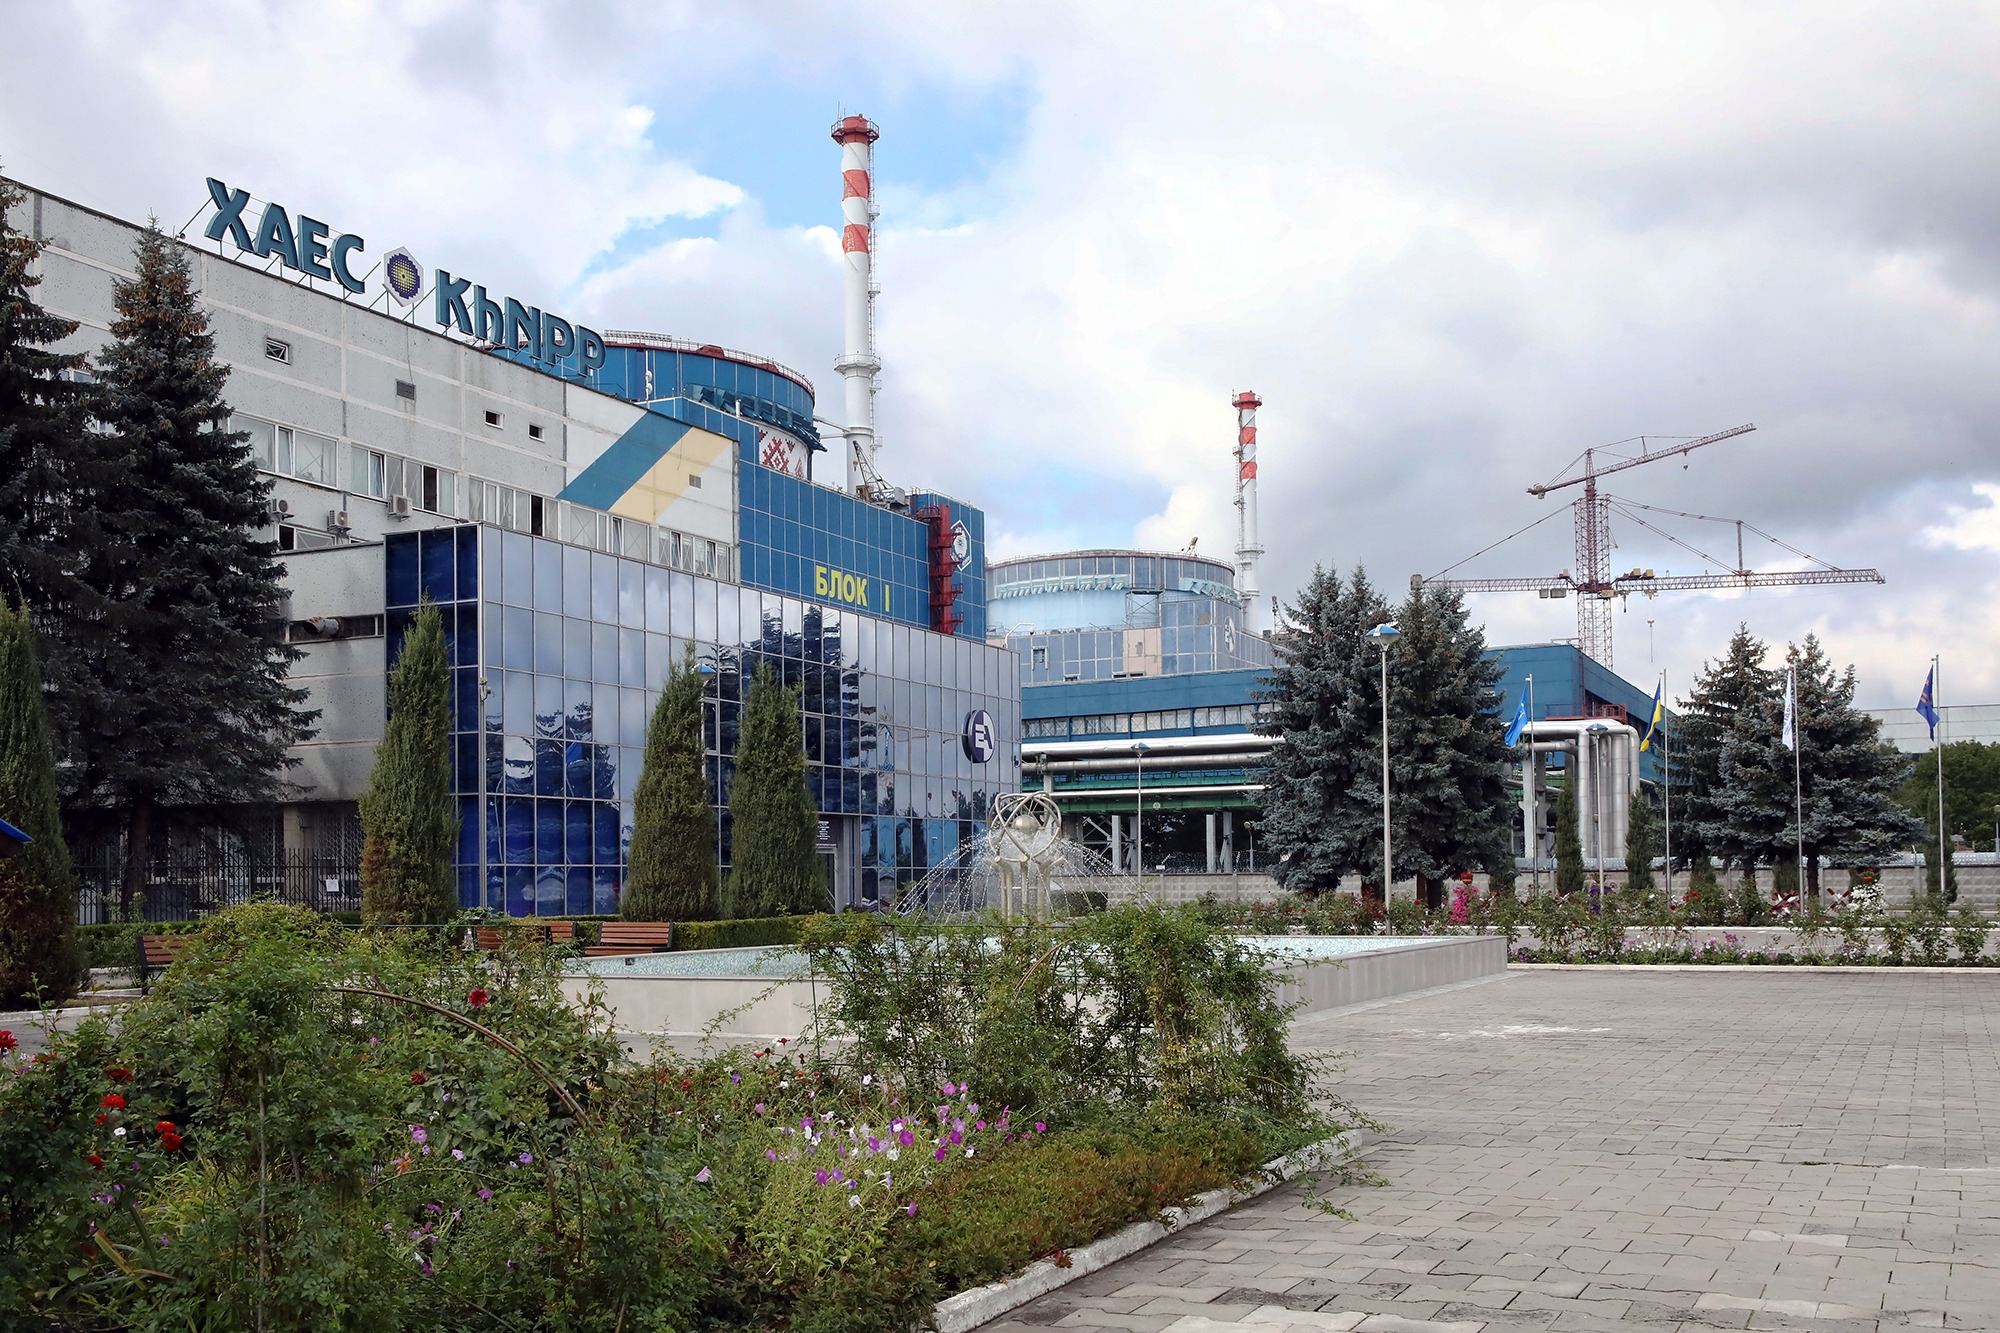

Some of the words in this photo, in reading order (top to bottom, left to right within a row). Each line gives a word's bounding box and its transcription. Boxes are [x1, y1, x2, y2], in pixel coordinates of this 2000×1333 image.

[204, 176, 365, 294] ХАЕС
[435, 268, 606, 378] KhNPP
[815, 565, 868, 607] БЛОК
